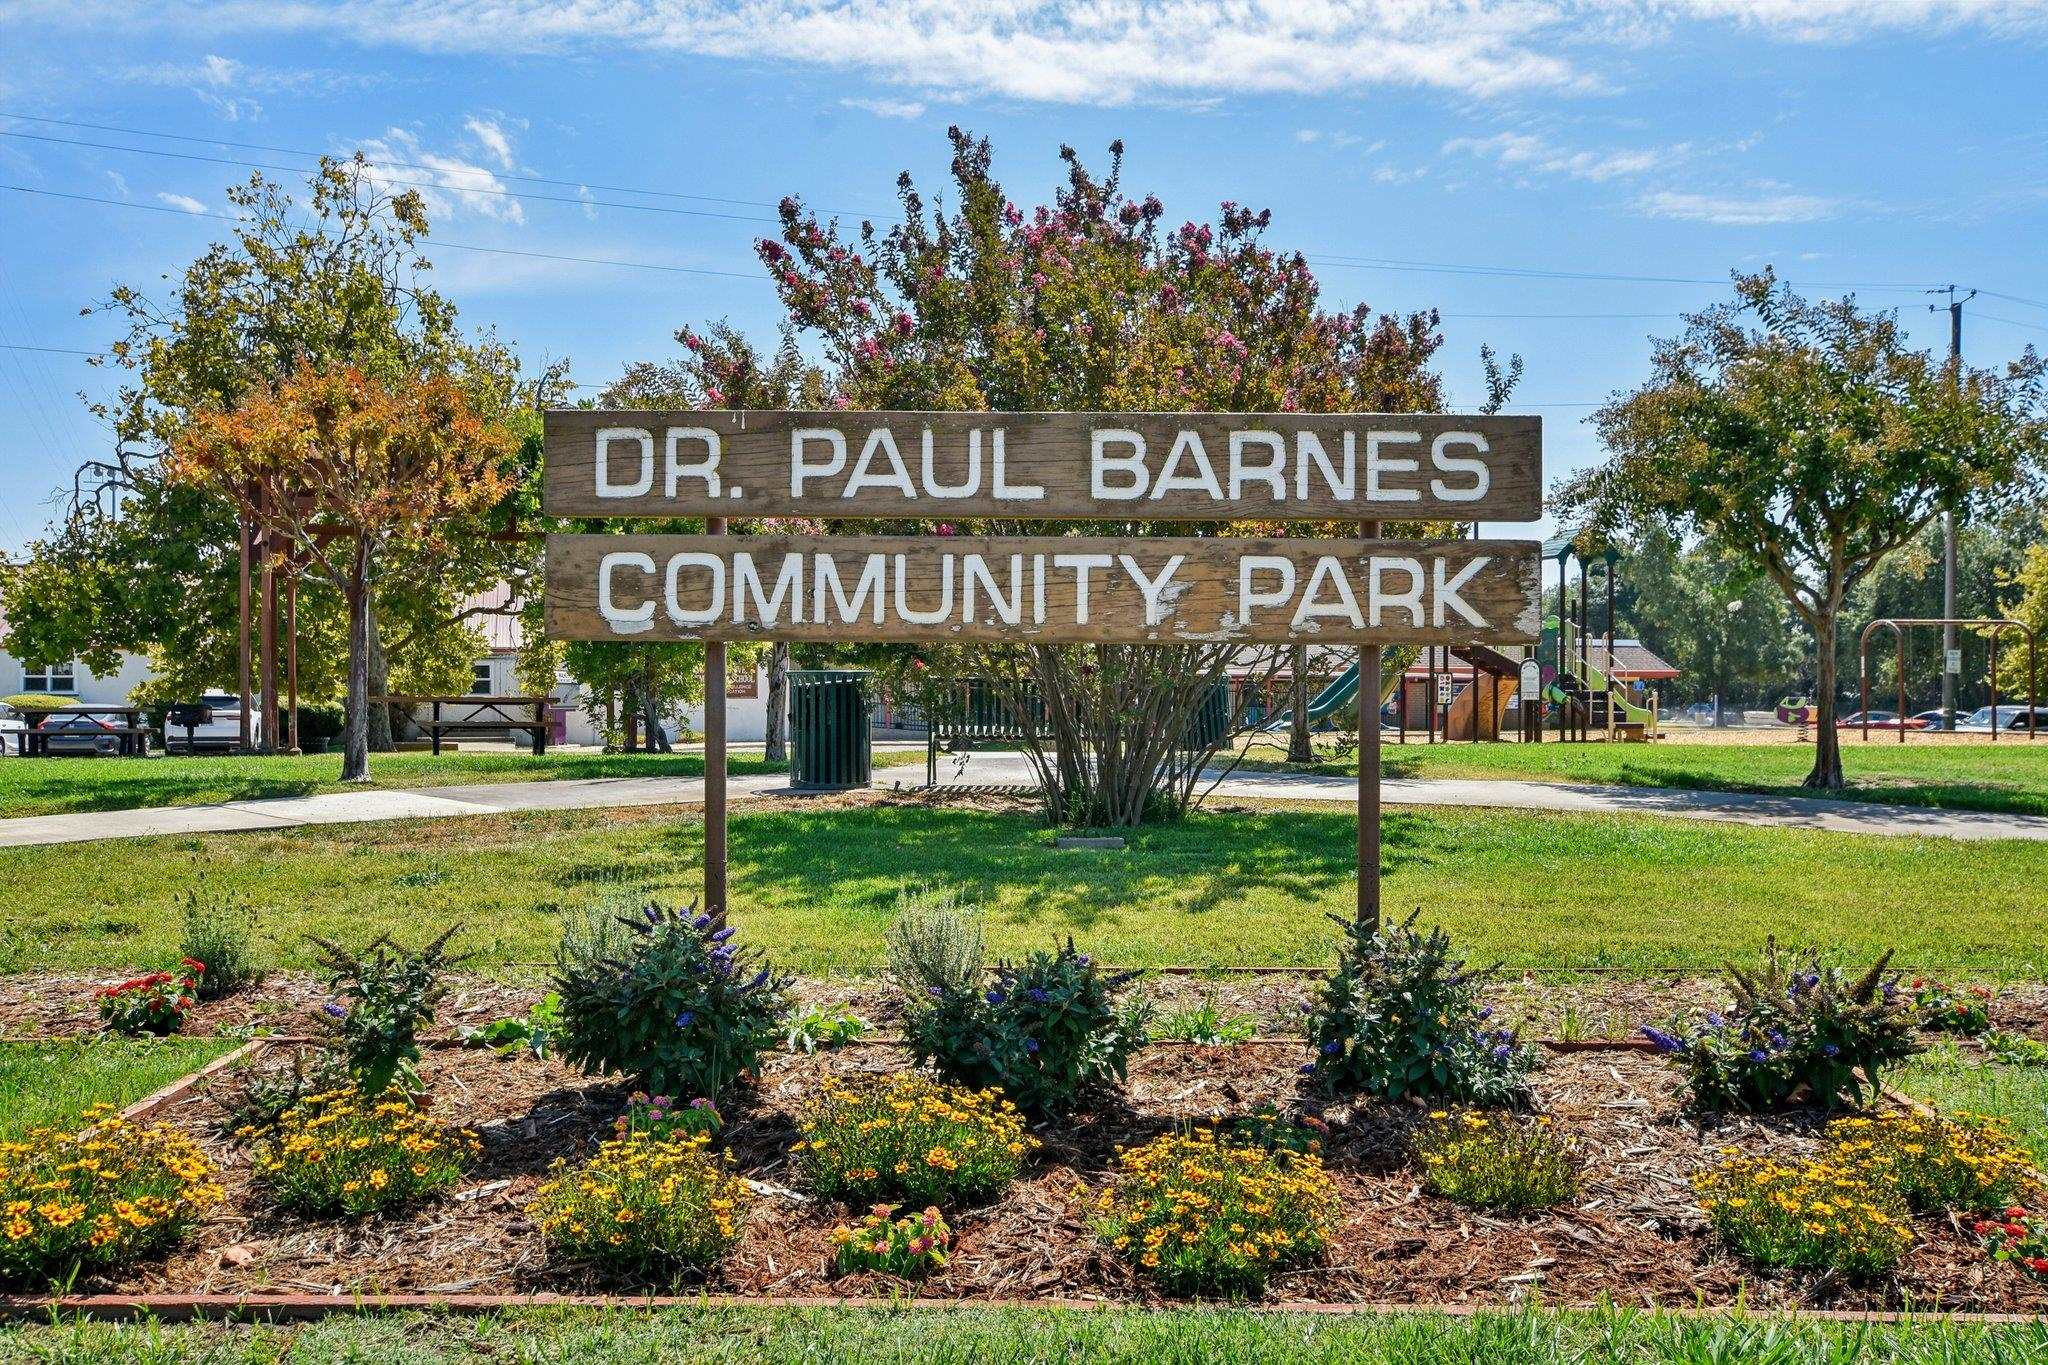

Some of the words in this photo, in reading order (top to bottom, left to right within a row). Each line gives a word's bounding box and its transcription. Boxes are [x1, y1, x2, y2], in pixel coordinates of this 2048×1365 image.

[595, 427, 743, 499] DR.
[790, 427, 1046, 500] PAUL
[1090, 429, 1491, 502] BARNES
[598, 551, 1186, 626] COMMUNITY
[1239, 555, 1492, 629] PARK
